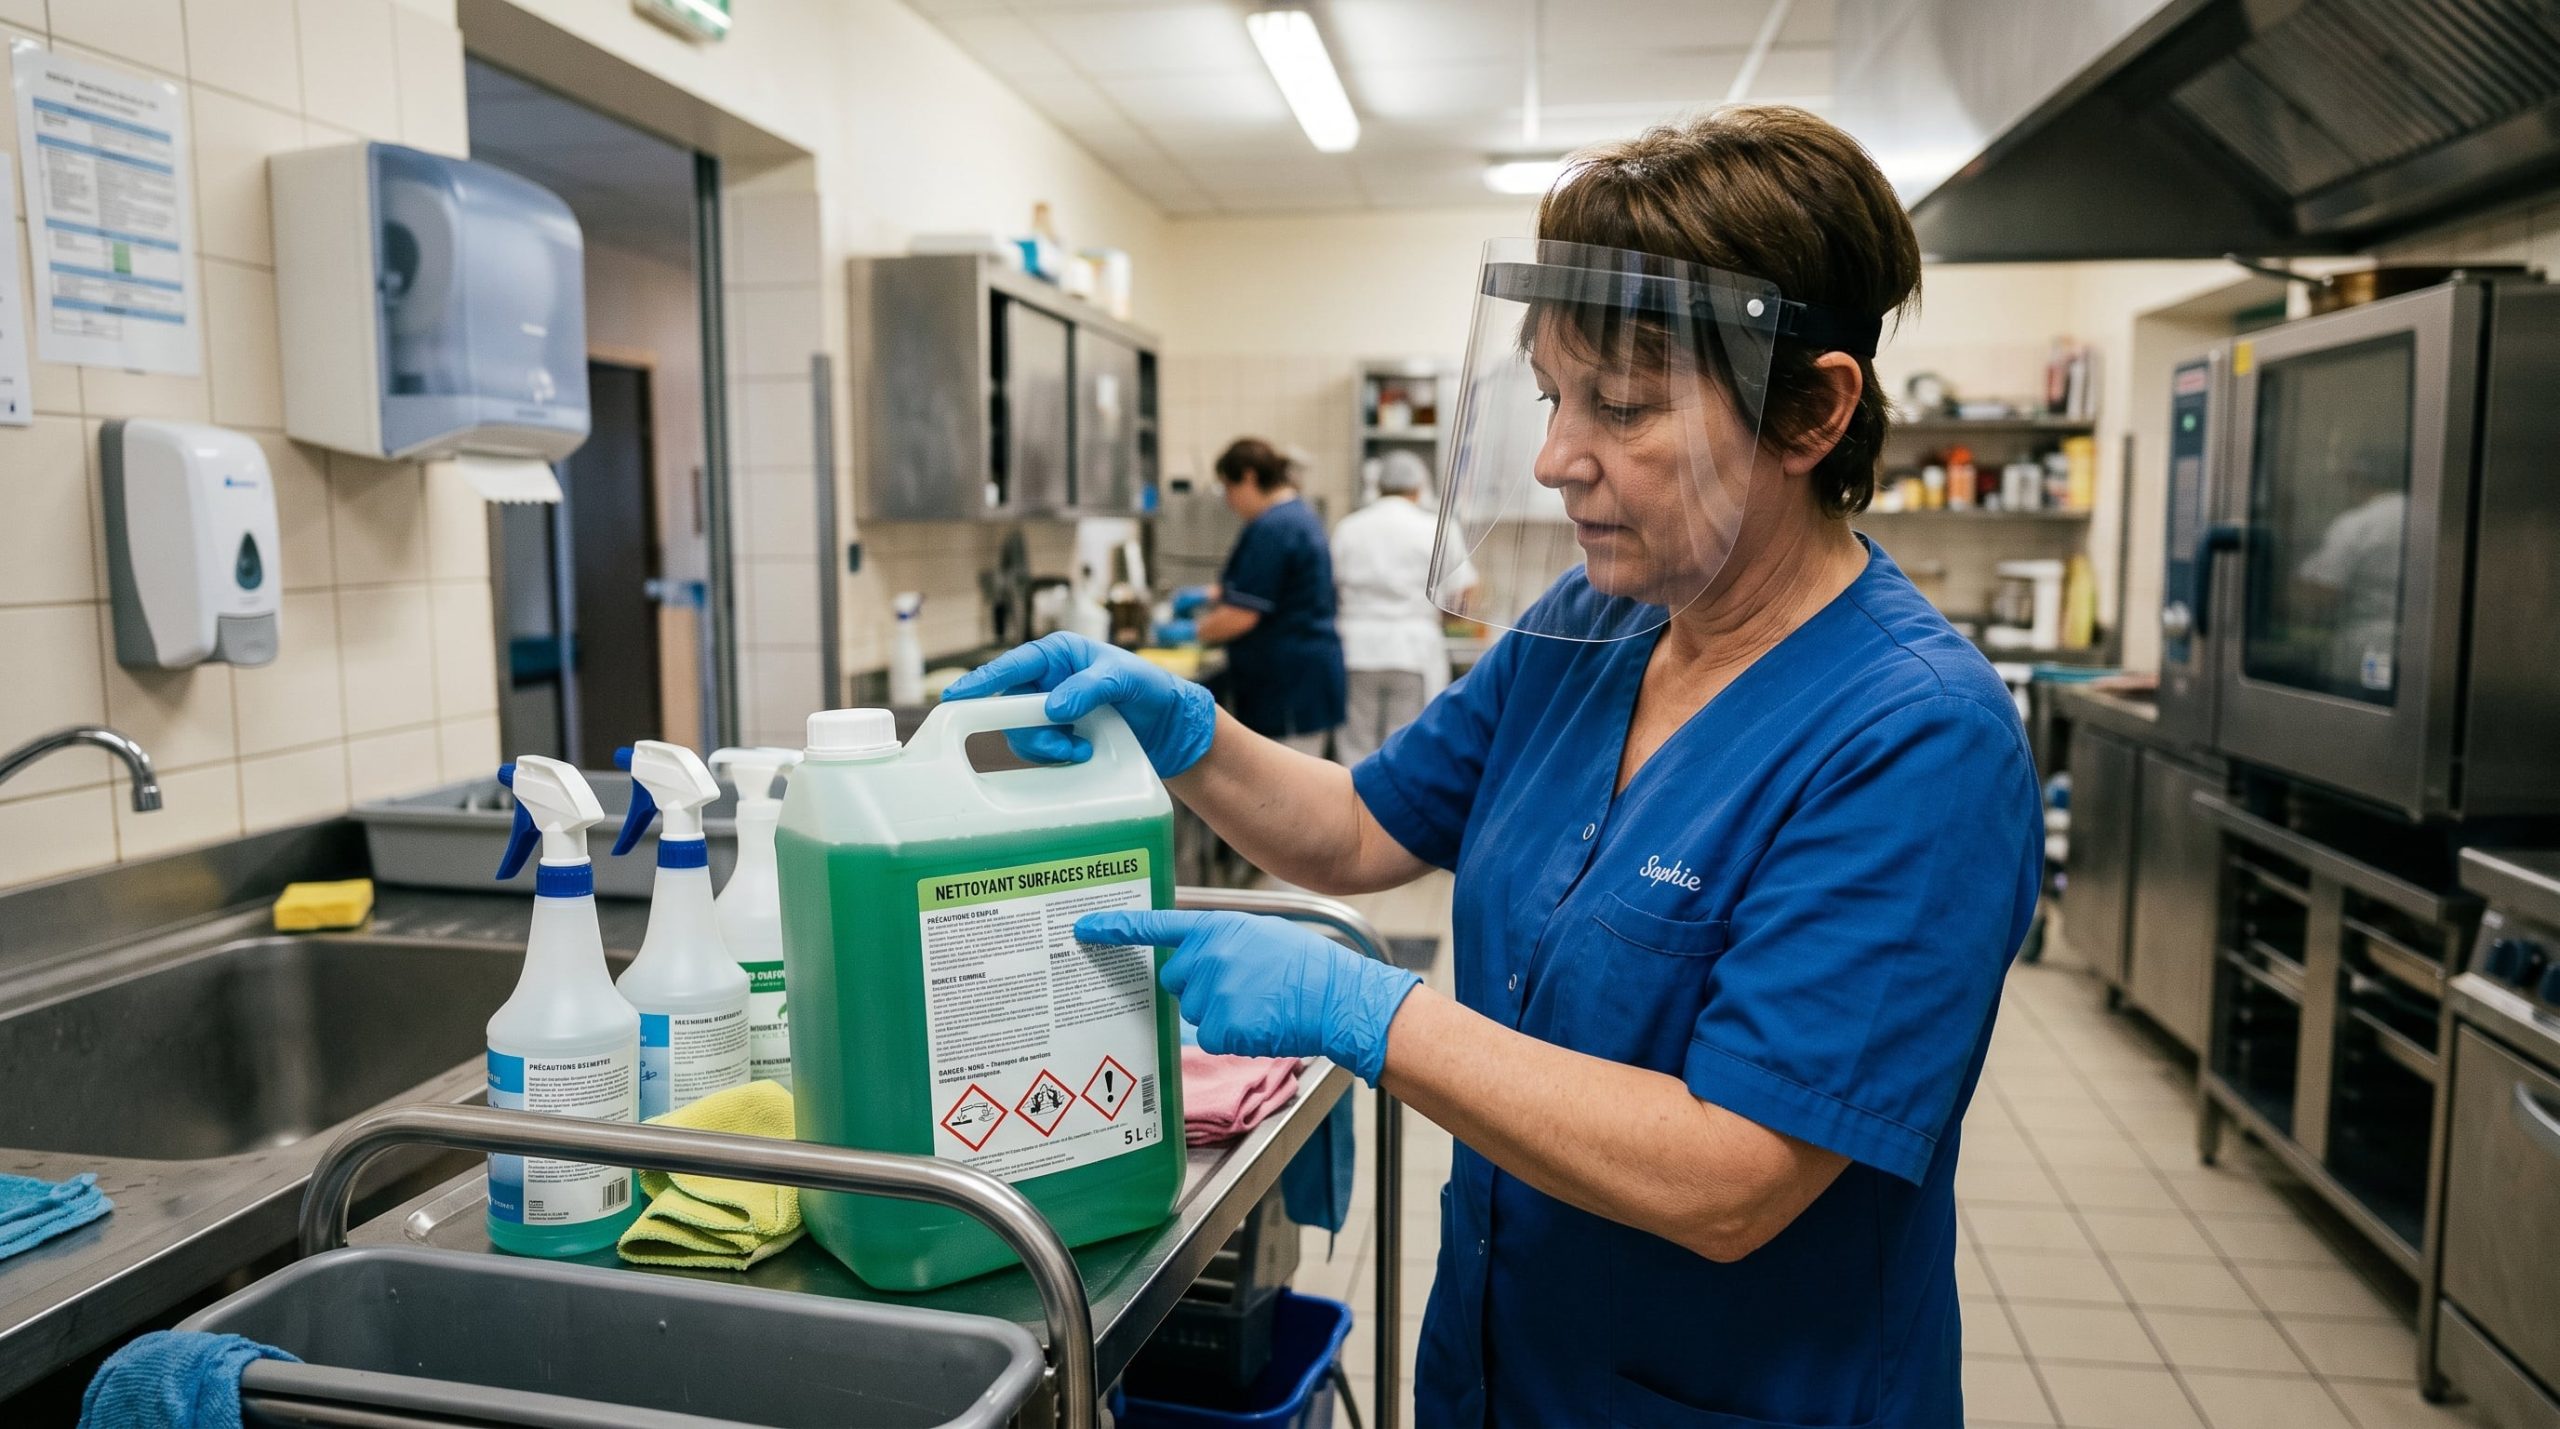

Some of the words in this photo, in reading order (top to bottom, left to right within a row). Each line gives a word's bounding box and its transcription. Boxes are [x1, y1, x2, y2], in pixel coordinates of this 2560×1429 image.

[936, 876, 1014, 901] NETTOYANT
[1018, 867, 1083, 889] SURFACES
[1087, 859, 1138, 879] RÉELLES
[1640, 855, 1701, 891] Sophie
[1125, 1130, 1133, 1145] 5
[1136, 1127, 1143, 1141] L
